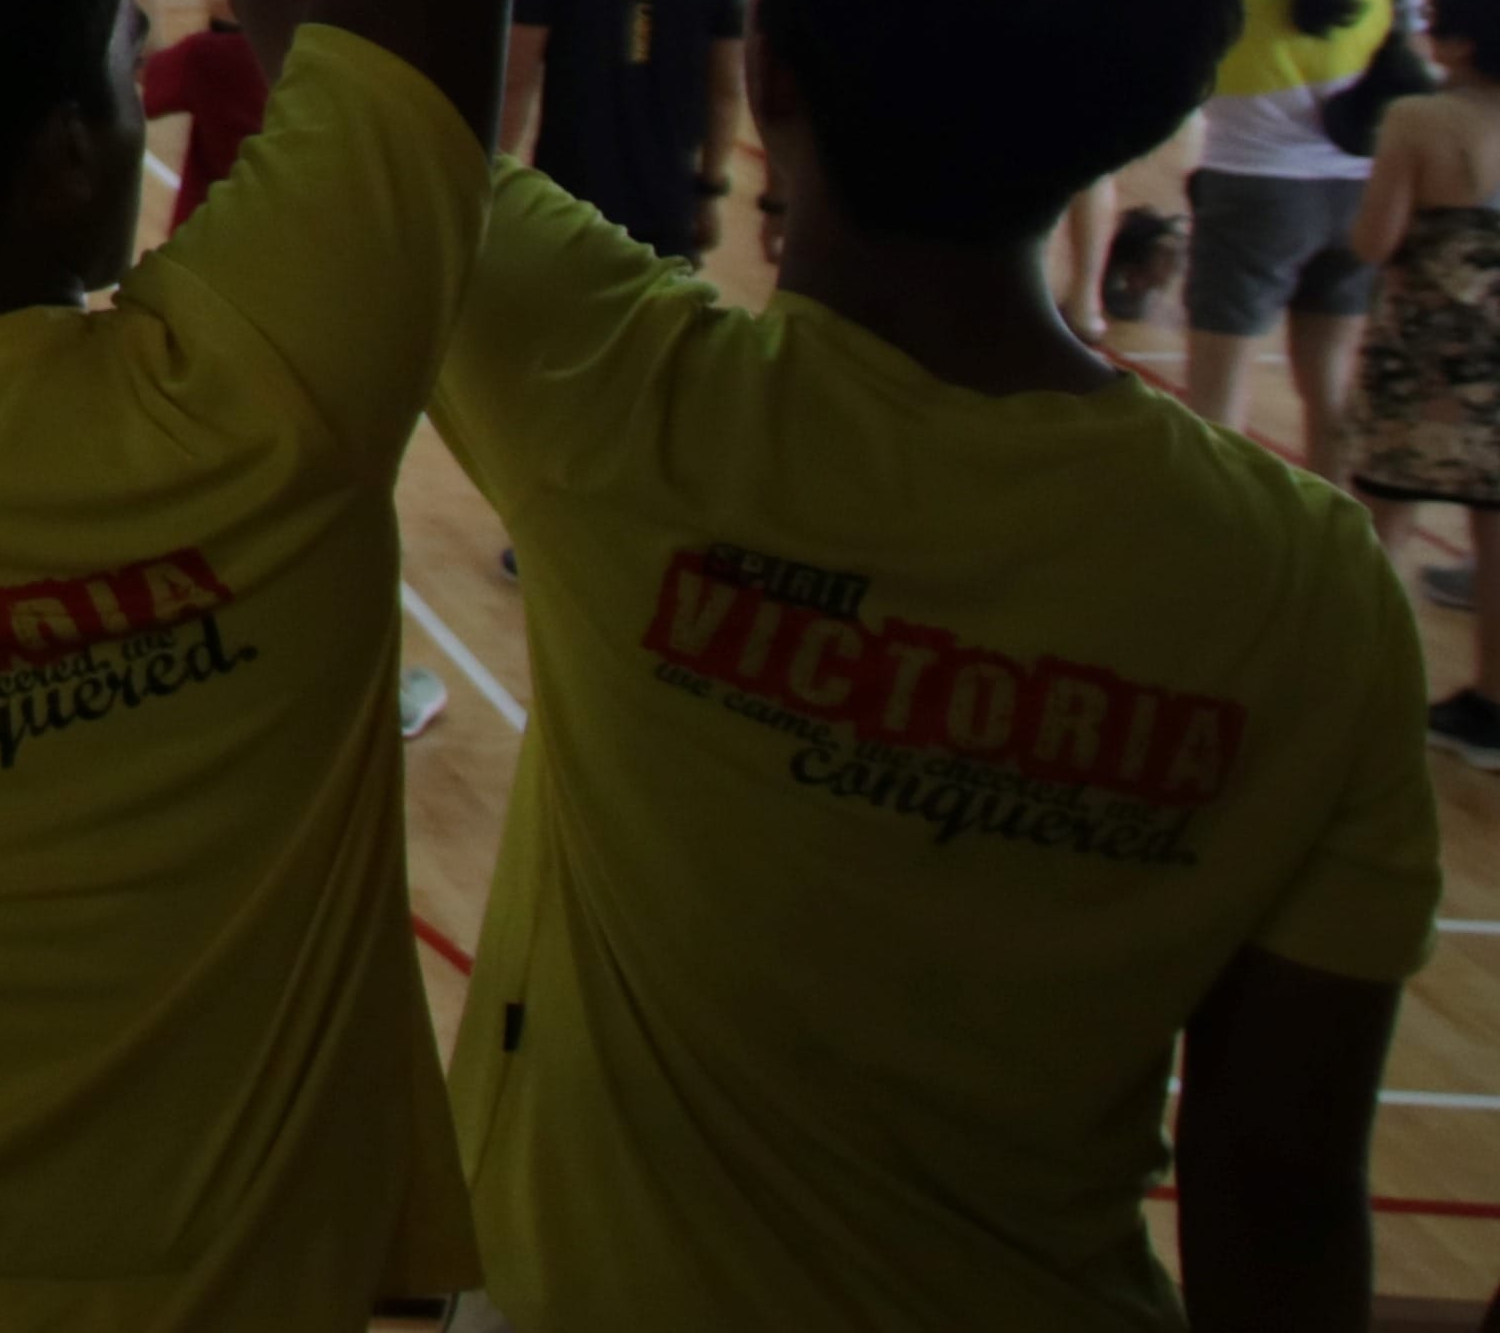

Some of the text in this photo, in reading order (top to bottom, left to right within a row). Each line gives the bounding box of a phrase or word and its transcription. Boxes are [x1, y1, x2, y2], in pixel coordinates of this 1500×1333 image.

[706, 545, 869, 617] SPIRIT
[668, 571, 1225, 795] VICTORIA
[789, 746, 1197, 865] conquered.
